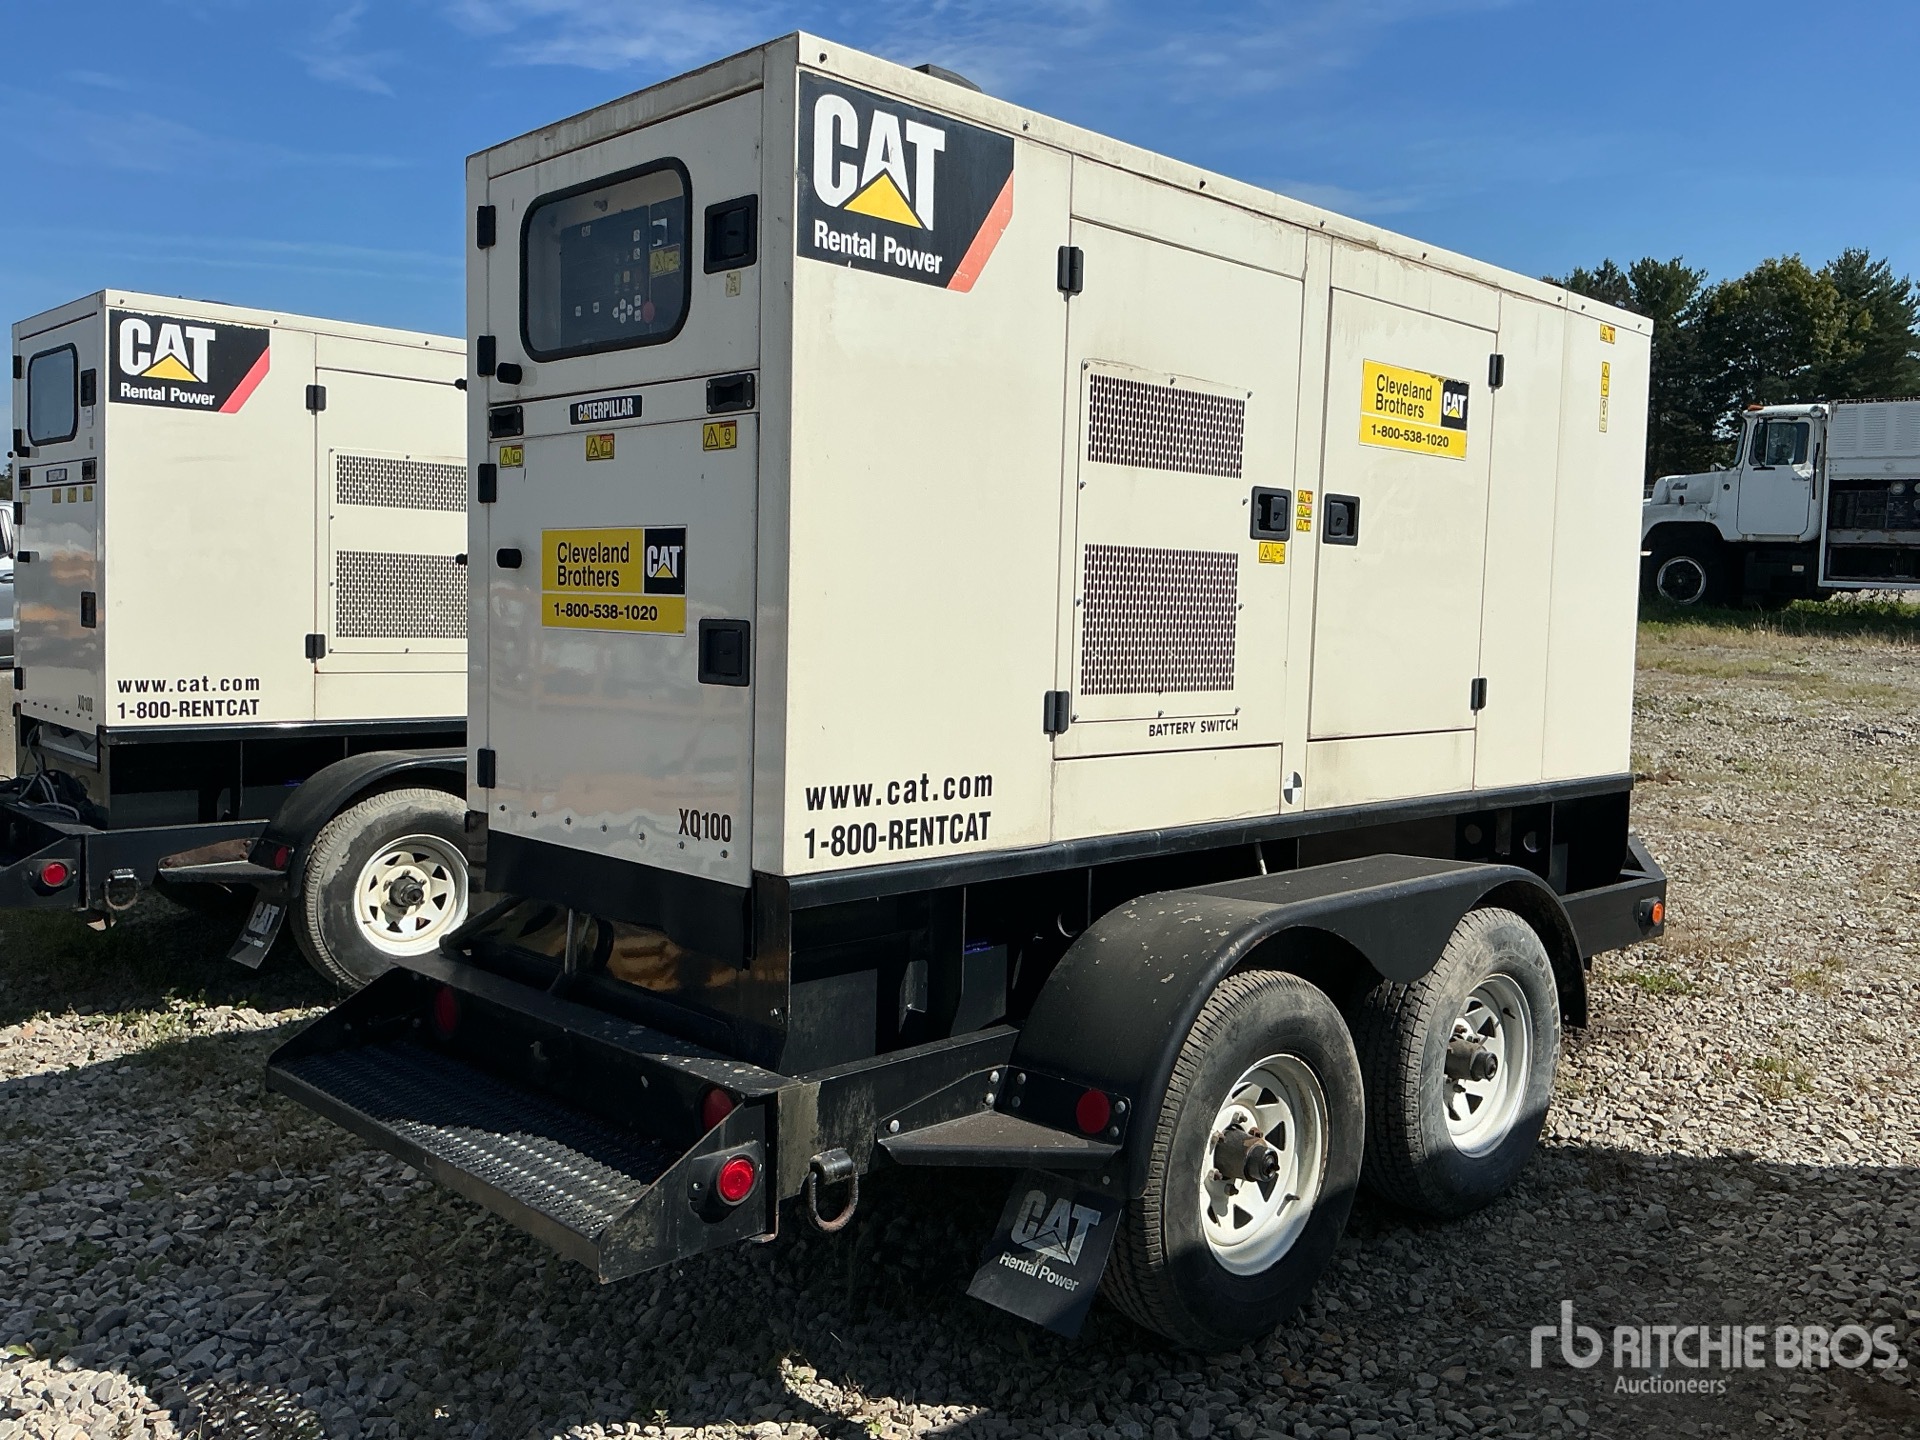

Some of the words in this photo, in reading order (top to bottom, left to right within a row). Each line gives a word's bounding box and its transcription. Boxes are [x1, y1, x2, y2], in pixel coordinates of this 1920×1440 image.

[813, 93, 946, 231] CAT
[814, 219, 877, 260] Rental
[883, 235, 943, 275] Power
[119, 317, 216, 383] CAT
[120, 382, 166, 401] Rental
[170, 387, 216, 406] Power
[1376, 373, 1433, 401] Cleveland
[577, 397, 634, 421] CATERPILLAR
[1375, 392, 1424, 418] Brothers
[1442, 391, 1467, 419] CAT
[1371, 423, 1449, 448] 1-800-538-1020
[557, 541, 630, 563] Cleveland
[646, 545, 681, 578] CAT
[557, 565, 620, 587] Brothers
[554, 602, 658, 621] 1-800-538-1020
[117, 675, 260, 693] www.cat.com
[117, 699, 260, 719] 1-800-RENTCAT
[1148, 721, 1196, 737] BATTERY
[1200, 718, 1239, 733] SWITCH
[805, 773, 993, 811] www.cat.com
[678, 808, 732, 843] XQ100
[804, 811, 992, 859] 1-800-RENTCAT
[248, 901, 280, 935] CAT
[1011, 1189, 1102, 1266] CAT
[999, 1251, 1038, 1278] Rental
[1038, 1265, 1080, 1291] Power
